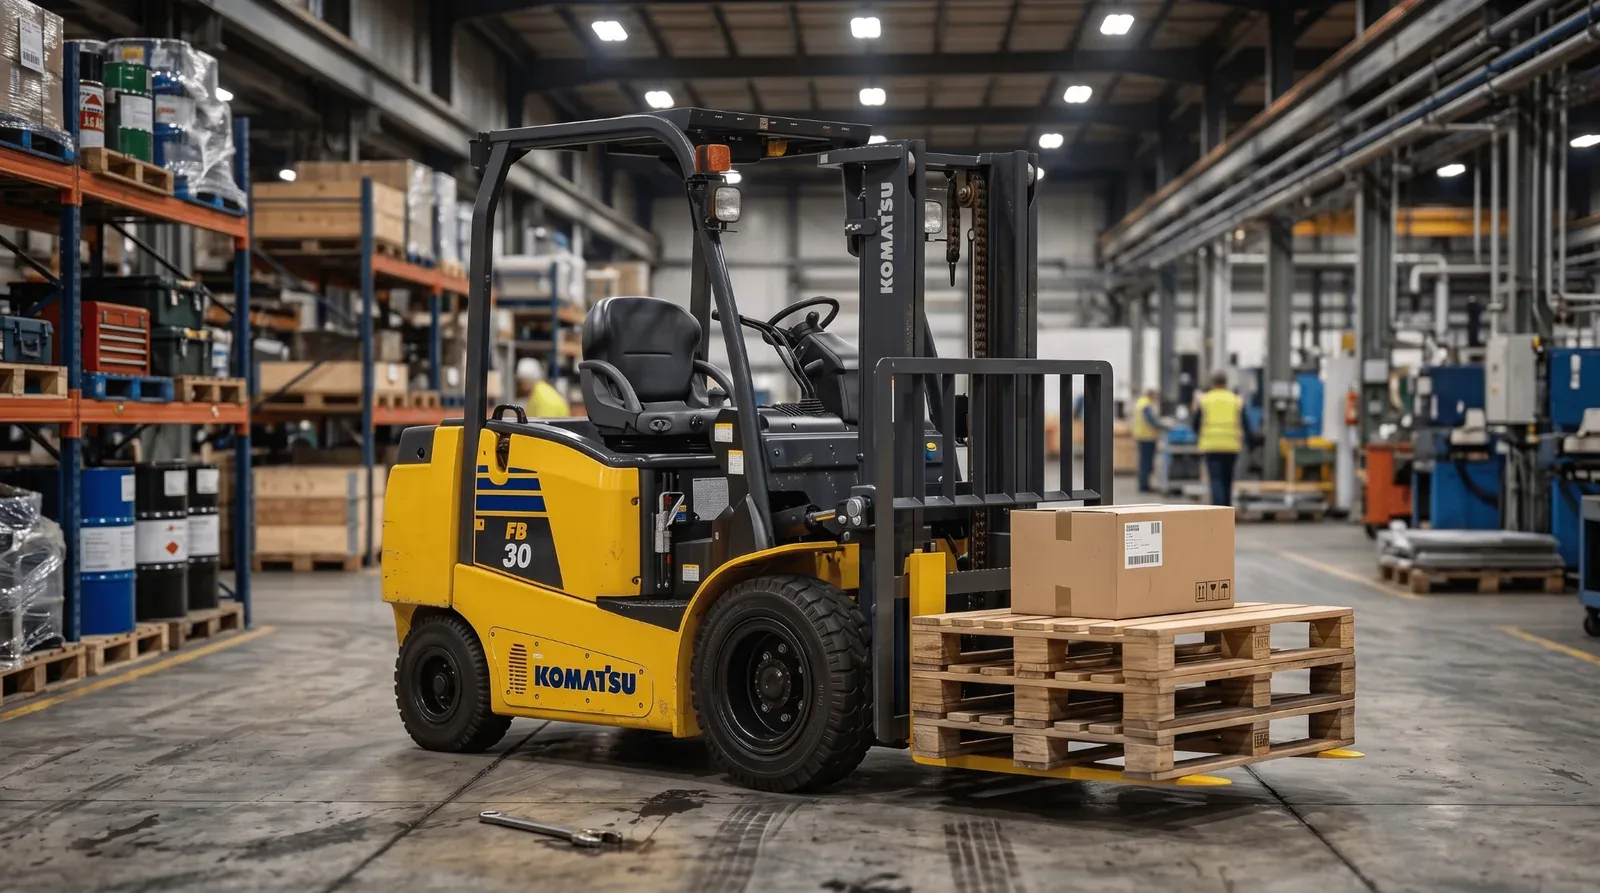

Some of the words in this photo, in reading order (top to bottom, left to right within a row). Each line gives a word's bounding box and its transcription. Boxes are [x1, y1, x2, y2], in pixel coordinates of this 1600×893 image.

[878, 182, 894, 294] KOMATSU
[505, 522, 528, 540] FB
[502, 543, 532, 569] 30
[534, 665, 636, 695] KOMATSU
